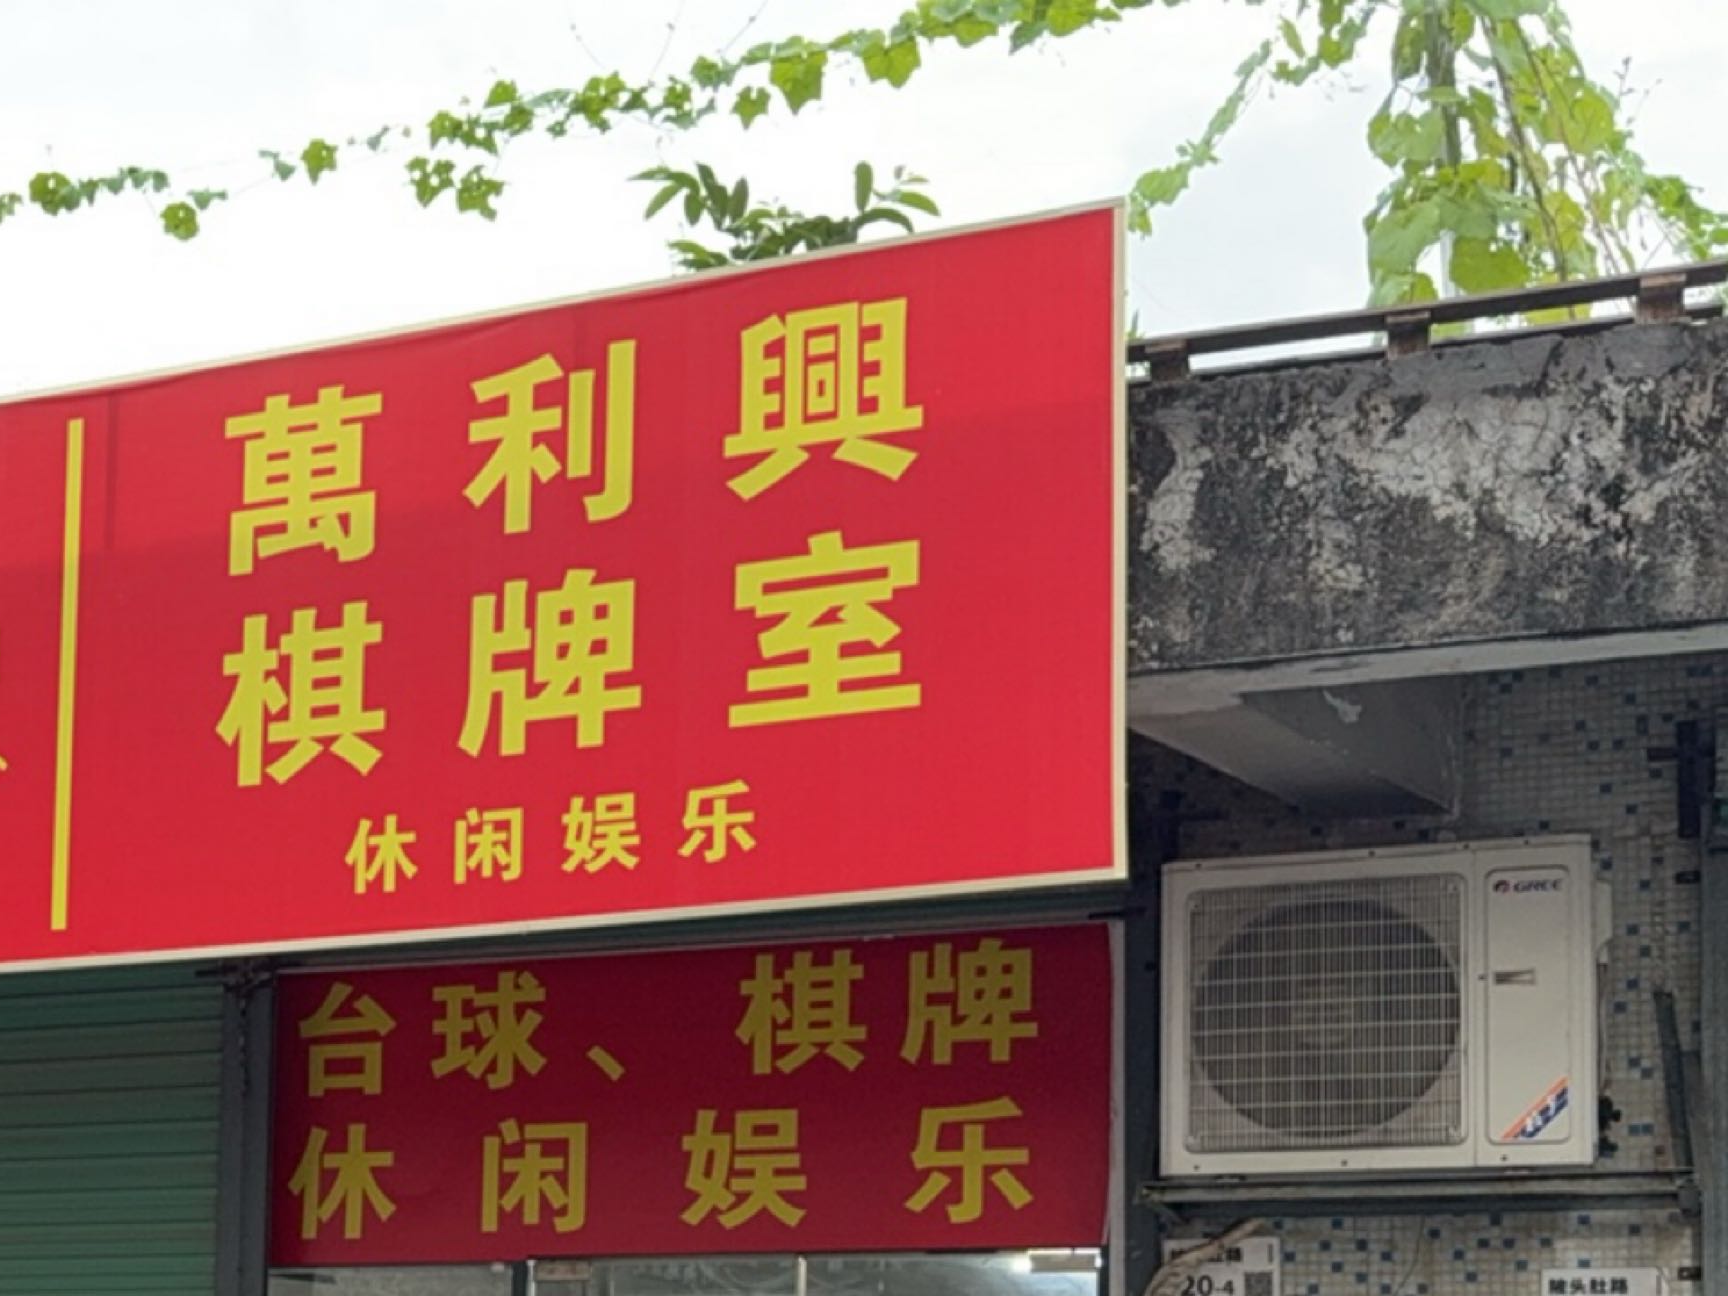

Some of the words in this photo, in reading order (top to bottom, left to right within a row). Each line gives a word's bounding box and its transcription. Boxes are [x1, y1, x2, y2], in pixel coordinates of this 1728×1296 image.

[224, 297, 923, 576] 萬利興
[216, 531, 921, 786] 棋牌室
[345, 780, 755, 893] 休闲娱乐
[1513, 878, 1562, 893] GREE
[297, 938, 1040, 1098] 台球、棋牌
[288, 1096, 1034, 1241] 休闲娱乐
